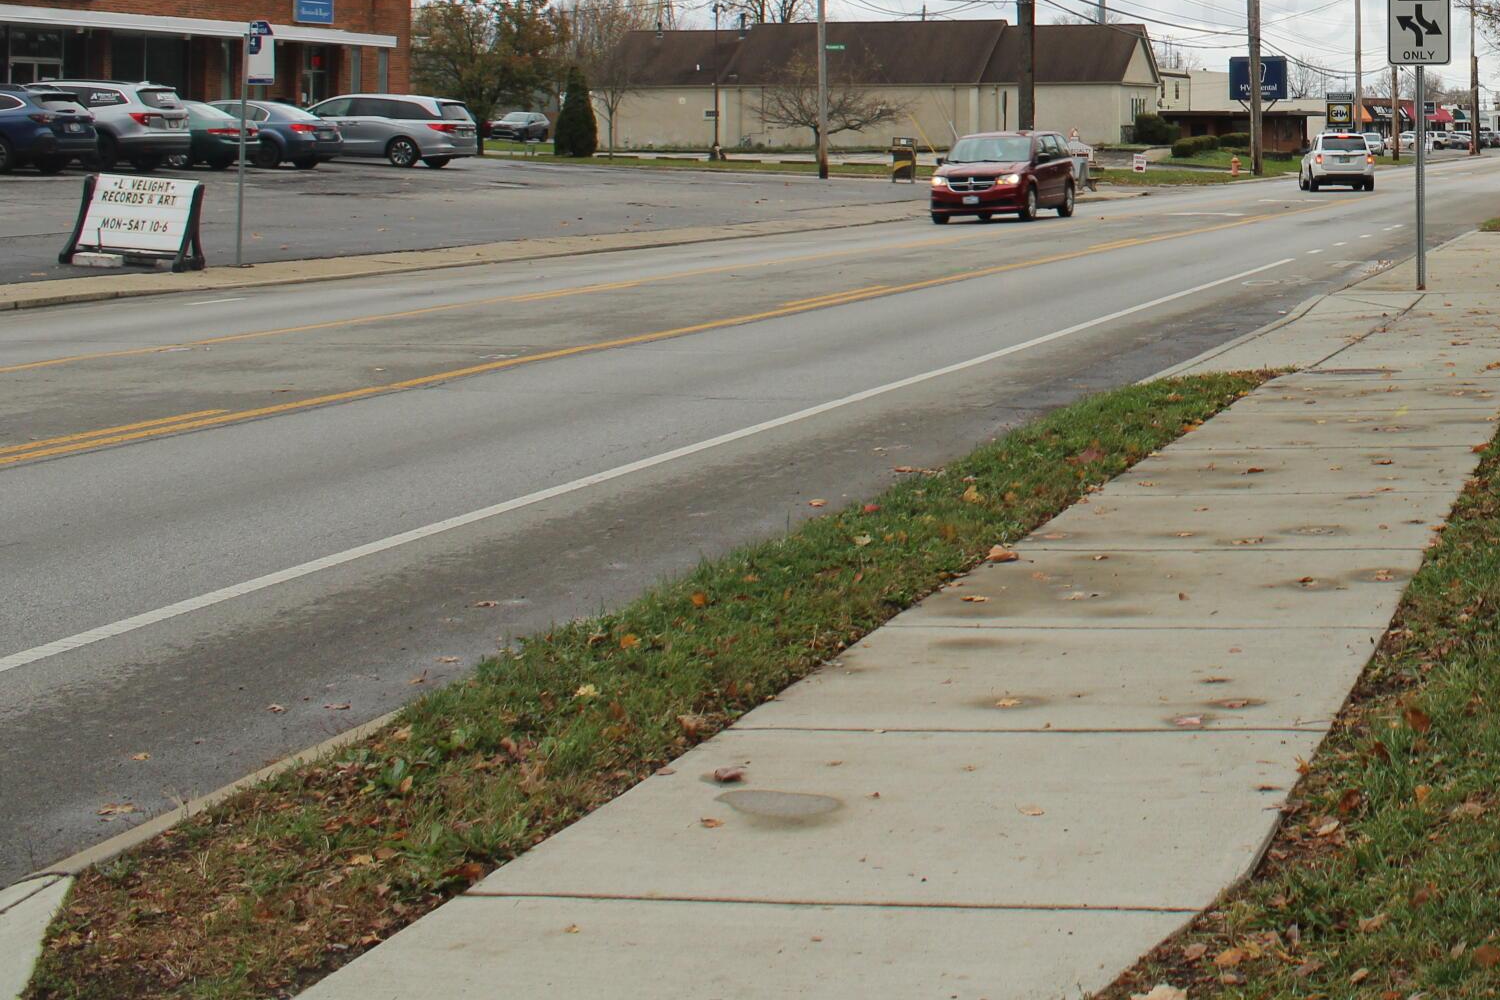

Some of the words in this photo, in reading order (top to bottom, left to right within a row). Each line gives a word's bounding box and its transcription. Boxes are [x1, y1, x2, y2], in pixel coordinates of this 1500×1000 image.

[250, 37, 256, 46] 4
[1403, 51, 1435, 60] ONLY
[1260, 83, 1277, 91] ental
[1331, 110, 1348, 118] GHM
[131, 181, 171, 192] VELIGHT
[102, 191, 144, 204] RECORDS
[147, 195, 153, 204] &
[158, 195, 176, 206] ART
[101, 218, 146, 231] MON-SAT
